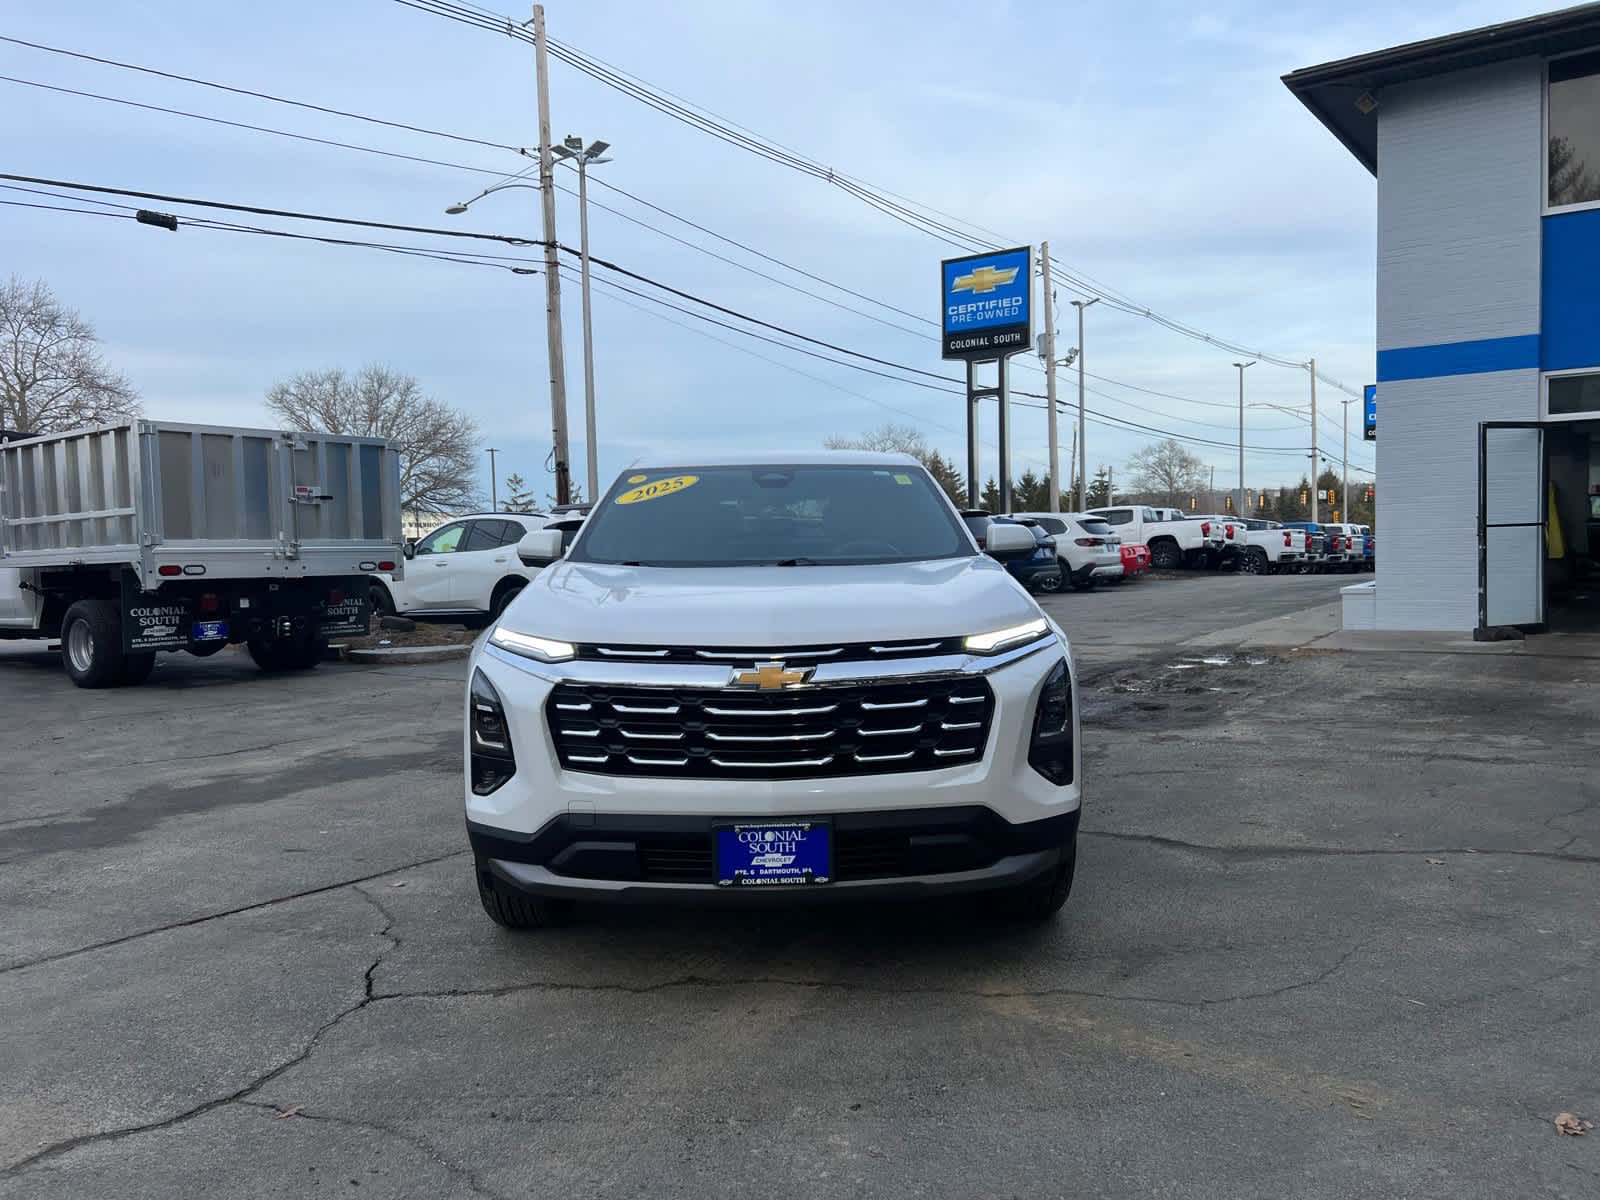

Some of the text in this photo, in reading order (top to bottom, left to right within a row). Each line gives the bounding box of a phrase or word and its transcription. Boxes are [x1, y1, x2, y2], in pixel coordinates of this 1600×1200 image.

[948, 296, 1023, 316] CERTIFIED
[951, 306, 1019, 324] PRE-OWNED
[950, 333, 1021, 349] COLONIAL SOUTH
[631, 477, 684, 501] 2025
[319, 598, 364, 608] CNIAL
[130, 606, 186, 617] COLONIAL
[327, 607, 358, 616] SOUTH
[139, 615, 180, 626] SOUTH
[738, 830, 807, 843] COLONIAL
[748, 842, 796, 854] SOUTH
